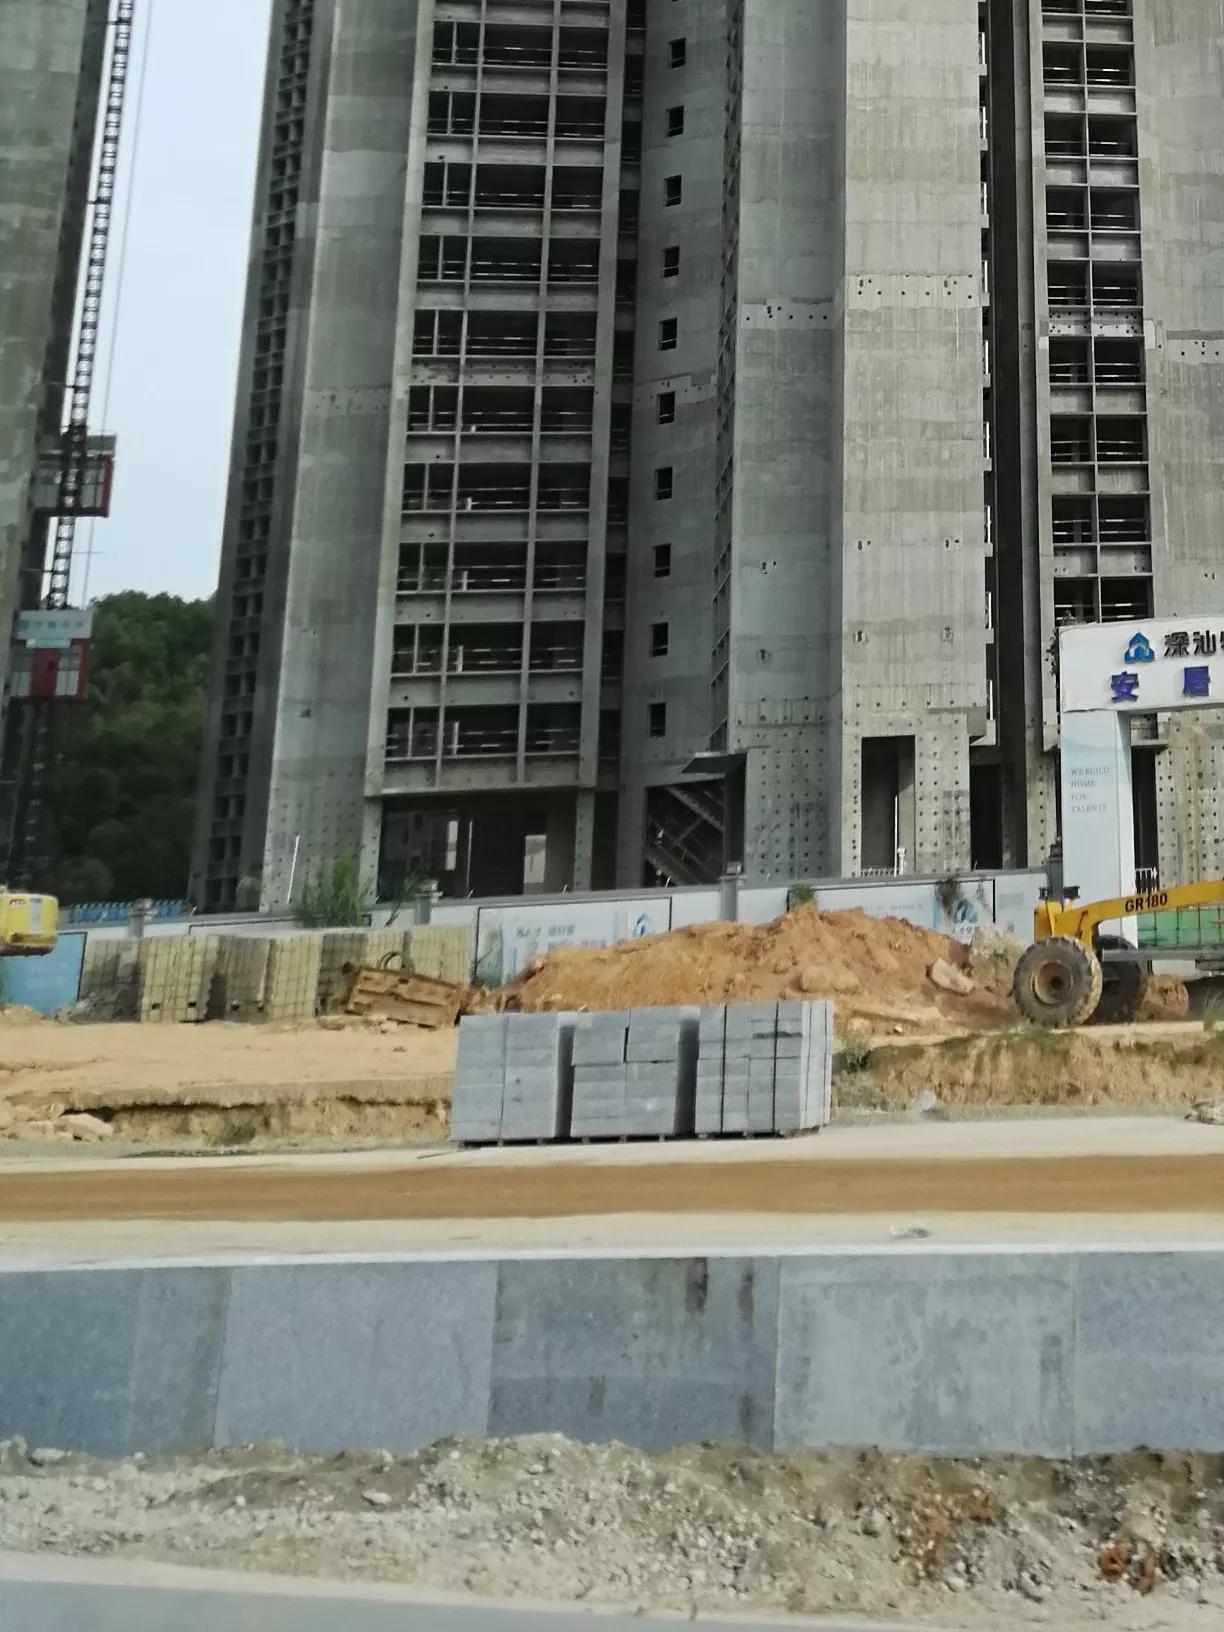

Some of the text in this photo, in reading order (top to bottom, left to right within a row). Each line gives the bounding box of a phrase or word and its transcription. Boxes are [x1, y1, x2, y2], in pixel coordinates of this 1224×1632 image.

[1071, 779, 1096, 789] HOME
[1071, 792, 1088, 801] FOR
[1125, 893, 1168, 914] GR180
